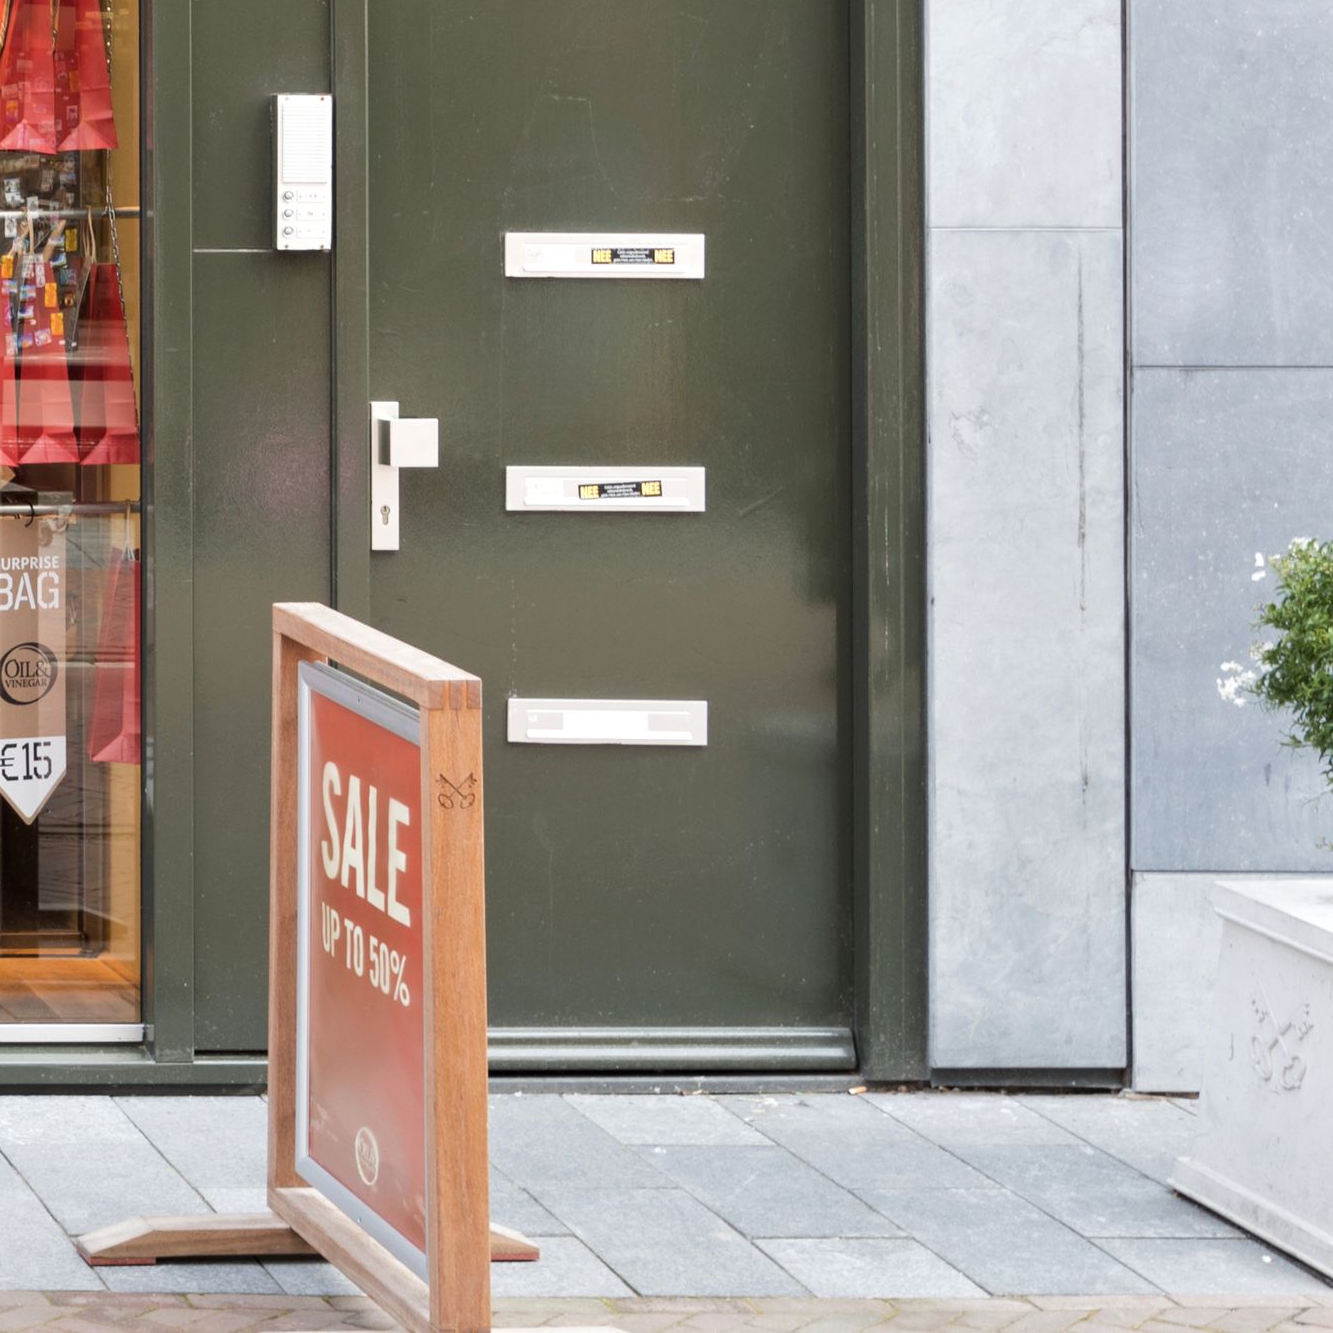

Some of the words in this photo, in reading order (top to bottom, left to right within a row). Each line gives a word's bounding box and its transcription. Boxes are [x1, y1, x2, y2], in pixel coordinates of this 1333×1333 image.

[5, 678, 48, 688] VINEGAR
[0, 741, 52, 781] €15
[320, 760, 412, 927] SALE
[321, 901, 340, 957] UP
[344, 918, 364, 978] TO
[368, 934, 411, 1008] 50%
